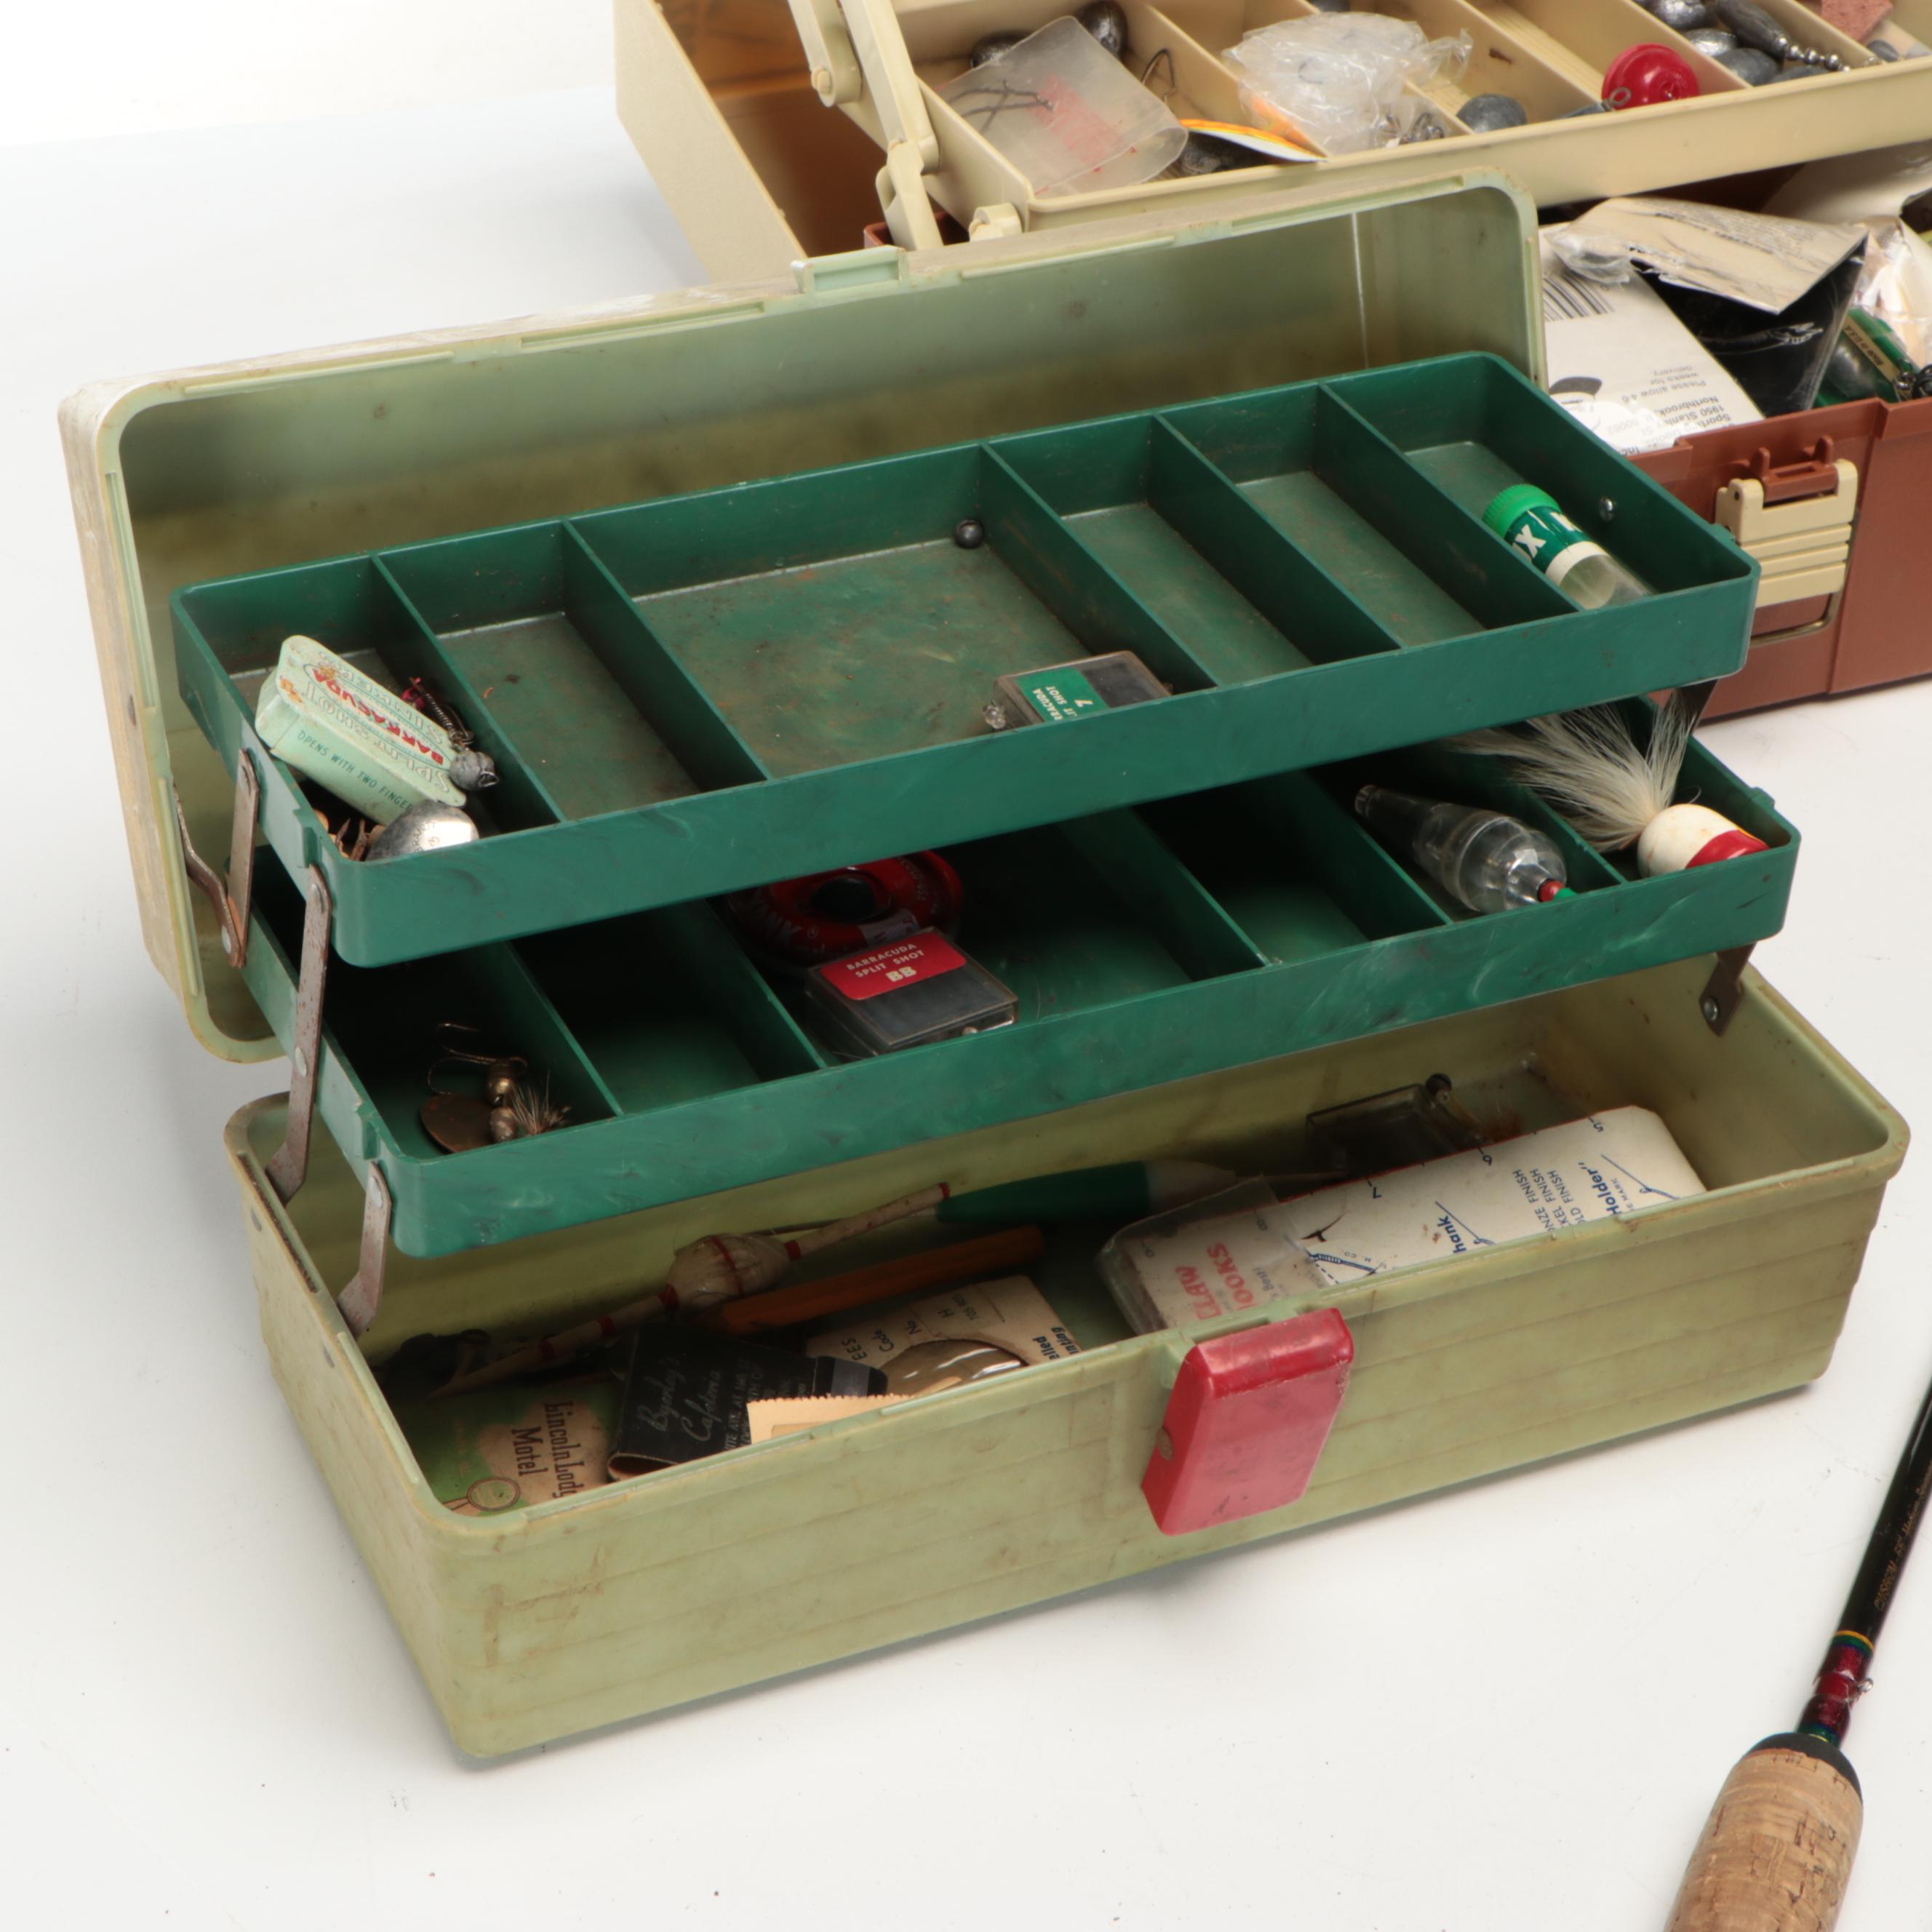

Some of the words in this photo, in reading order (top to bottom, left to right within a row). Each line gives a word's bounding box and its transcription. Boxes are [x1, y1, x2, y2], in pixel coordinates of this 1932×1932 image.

[1667, 372, 1699, 382] weeks
[1671, 380, 1707, 390] Please
[1621, 394, 1637, 404] 4-6
[1640, 386, 1669, 398] allow
[1700, 404, 1725, 416] 1950
[1045, 686, 1067, 705] SHOT
[303, 682, 370, 740] SHOT
[313, 667, 444, 765] BARRACUDA
[297, 730, 329, 756] OPENS
[331, 753, 355, 773] WITH
[357, 771, 378, 788] TWO
[374, 740, 450, 793] SPLIT
[846, 943, 917, 970] BARRACUDA
[855, 962, 887, 978] SPLIT
[893, 949, 925, 965] SHOT
[885, 966, 917, 982] BB
[1593, 1122, 1604, 1132] 5
[1482, 1154, 1493, 1166] 6
[1373, 1186, 1382, 1199] 7
[1513, 1169, 1539, 1203] FINISH
[1530, 1168, 1556, 1202] FINISH
[1548, 1170, 1574, 1204] FINISH
[1610, 1178, 1629, 1201] MARK
[842, 1338, 868, 1360] EES
[871, 1328, 894, 1352] Code
[541, 1400, 581, 1462] Lincoln
[511, 1426, 549, 1477] Motel
